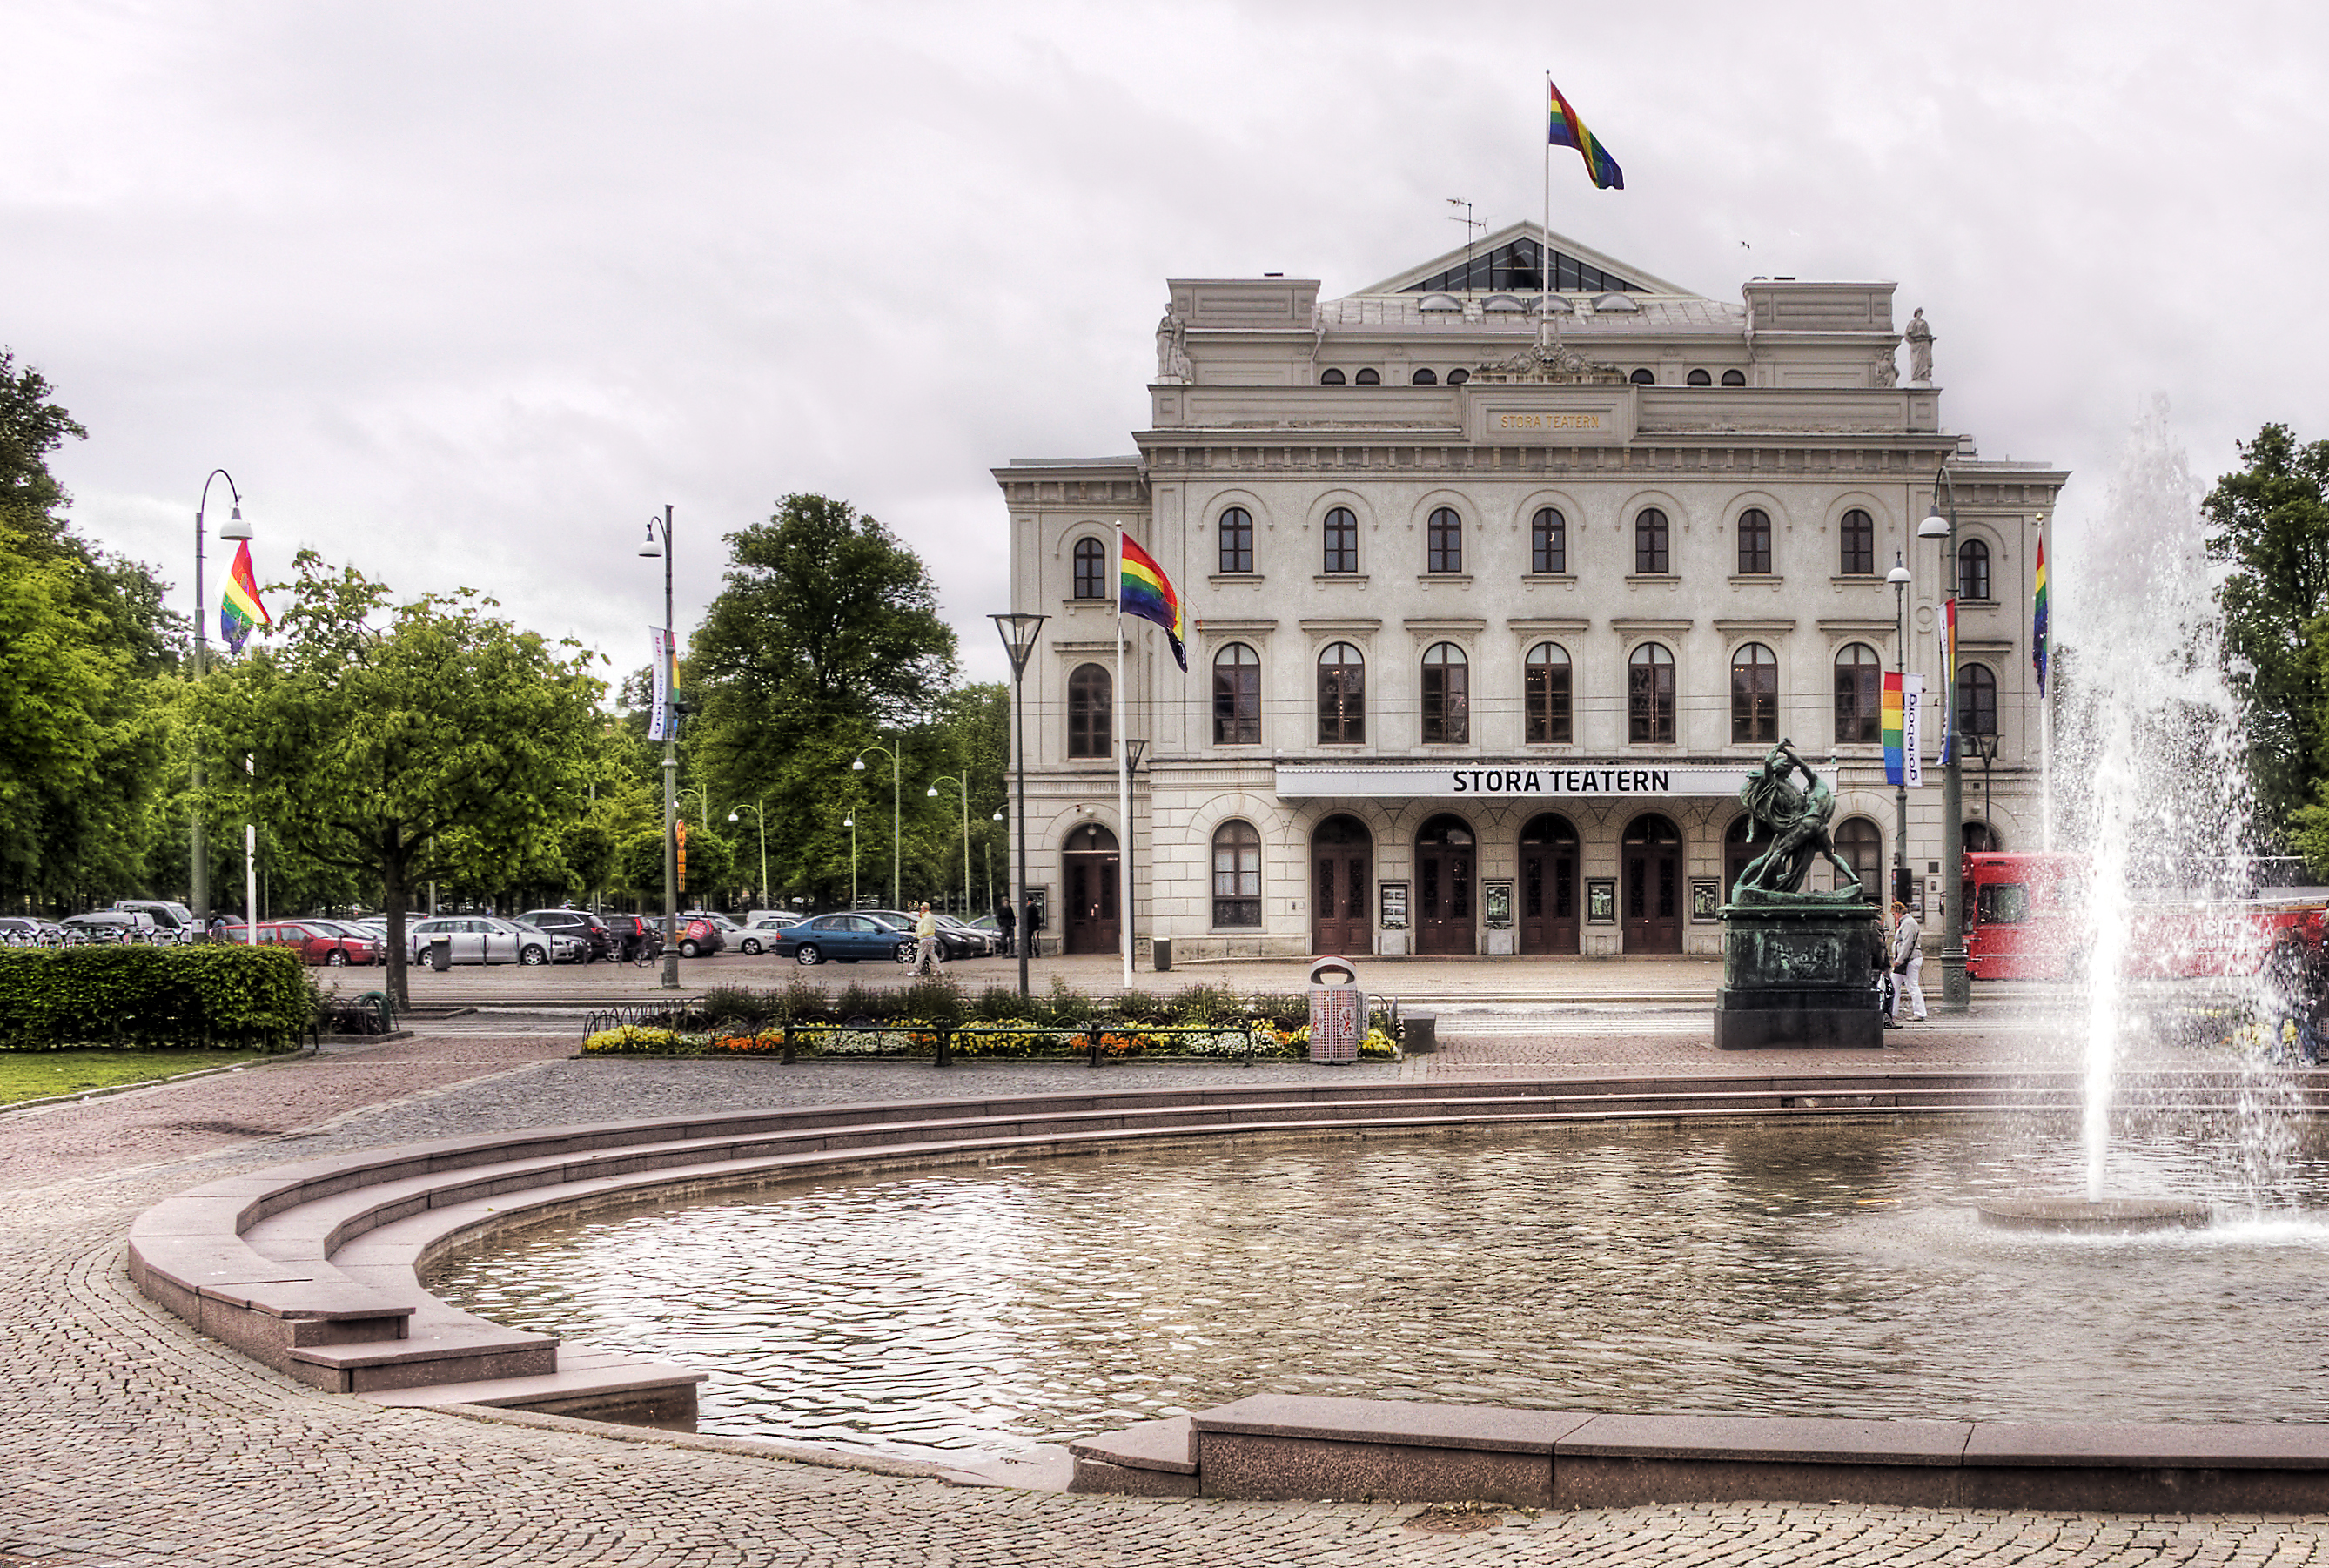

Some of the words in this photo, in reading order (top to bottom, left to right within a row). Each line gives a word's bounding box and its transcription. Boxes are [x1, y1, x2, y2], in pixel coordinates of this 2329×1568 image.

[1501, 414, 1541, 429] STORA
[1546, 414, 1600, 429] TEATERN
[1907, 693, 1918, 781] go:teborg
[1453, 770, 1541, 792] STORA
[1548, 770, 1669, 792] TEATERN
[2185, 938, 2272, 948] SIGHTSEEG
